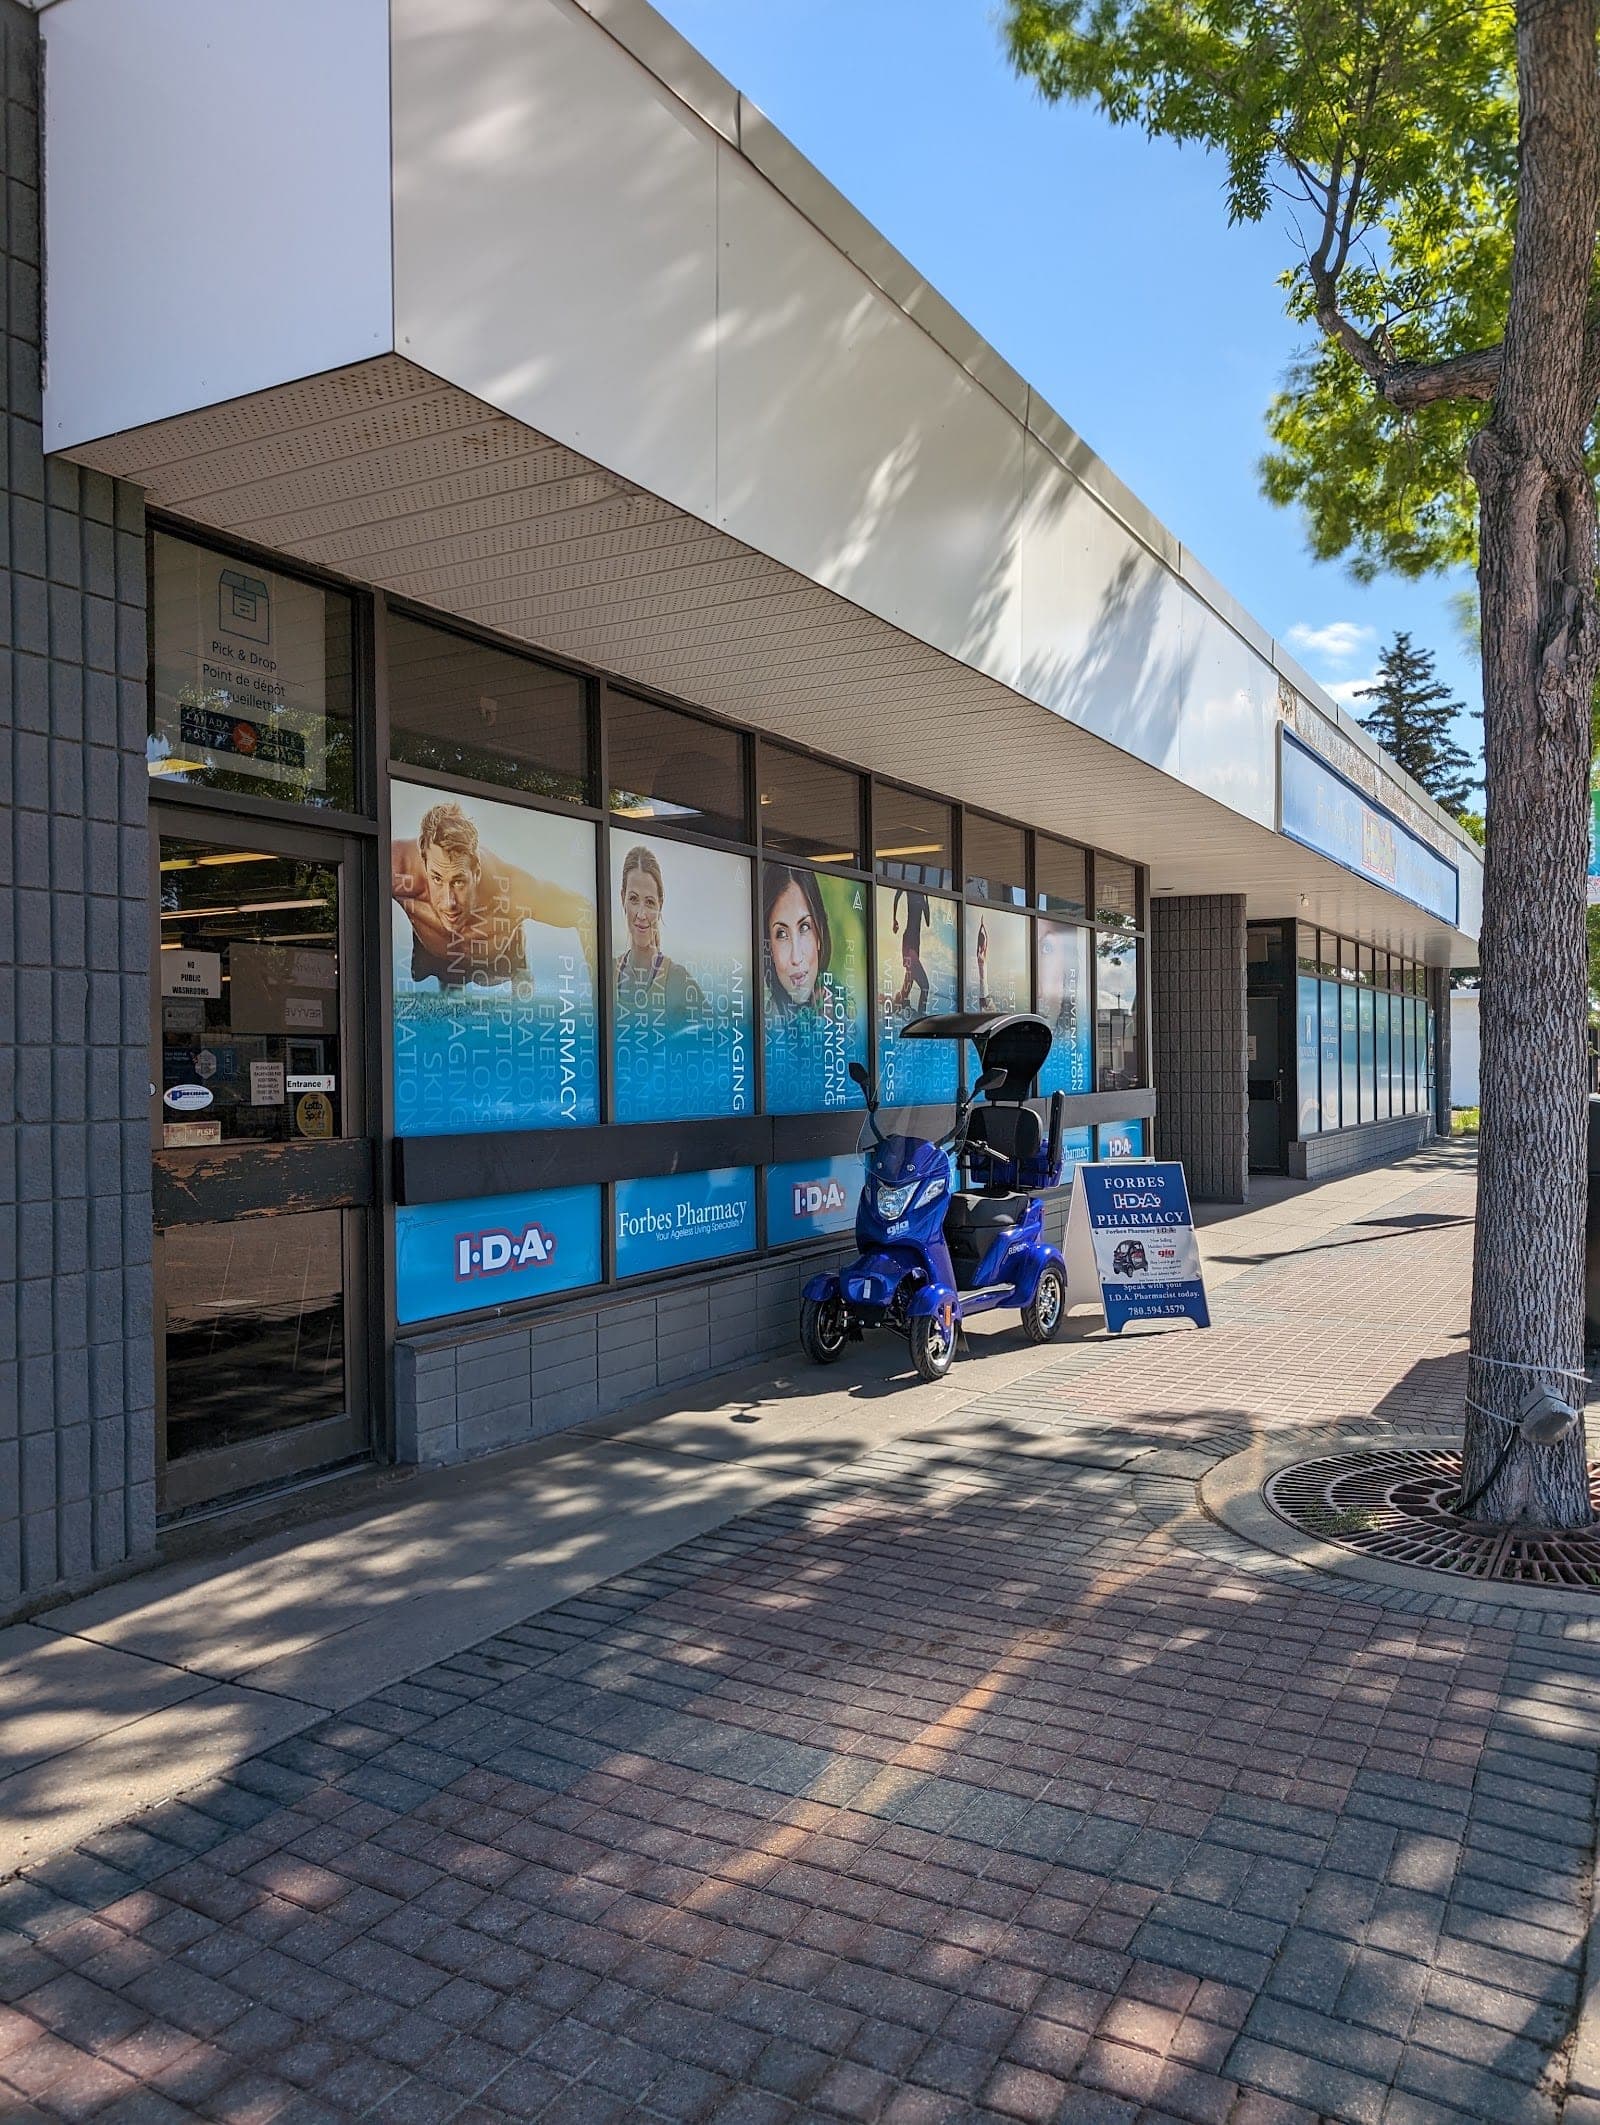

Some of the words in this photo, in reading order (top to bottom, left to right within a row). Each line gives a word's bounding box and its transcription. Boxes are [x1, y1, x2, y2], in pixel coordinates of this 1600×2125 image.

[212, 640, 234, 658] Pick
[237, 649, 246, 661] &
[249, 653, 277, 672] Drop
[202, 664, 232, 682] Point
[236, 674, 250, 686] de
[253, 677, 287, 697] dépôt
[180, 974, 201, 982] PUBLIC
[187, 961, 195, 969] NO
[471, 904, 490, 1038] WEIGHT
[171, 986, 209, 996] WASHROOMS
[493, 874, 513, 1125] PRESCRIPTIONS
[883, 958, 894, 1045] WEIGHT
[515, 904, 535, 1120] RESTORATION
[558, 954, 577, 1122] PHARMACY
[634, 966, 648, 1115] HORMONE
[731, 958, 745, 1112] ANTI-AGING
[823, 971, 835, 1107] BALANCING
[835, 985, 845, 1106] HORMONE
[538, 1003, 556, 1120] ENERGY
[883, 1050, 896, 1102] LOSS
[287, 1080, 322, 1088] Entrance
[423, 1051, 444, 1128] SKIN
[471, 1047, 491, 1126] LOSS
[304, 1100, 323, 1110] Lotto
[1104, 1176, 1165, 1189] FORBES
[618, 1207, 672, 1238] Forbes
[676, 1200, 748, 1228] Pharmacy
[656, 1231, 670, 1242] Your
[670, 1227, 694, 1241] Ageless
[694, 1224, 711, 1236] Living
[886, 1220, 910, 1236] gio
[1096, 1211, 1185, 1226] PHARMACY
[1109, 1294, 1132, 1302] I.D.A.
[1134, 1292, 1176, 1300] Pharmacist
[1178, 1290, 1200, 1299] today.
[1123, 1282, 1145, 1292] Speak
[1166, 1282, 1182, 1291] your
[1128, 1304, 1185, 1316] 780.594.3579
